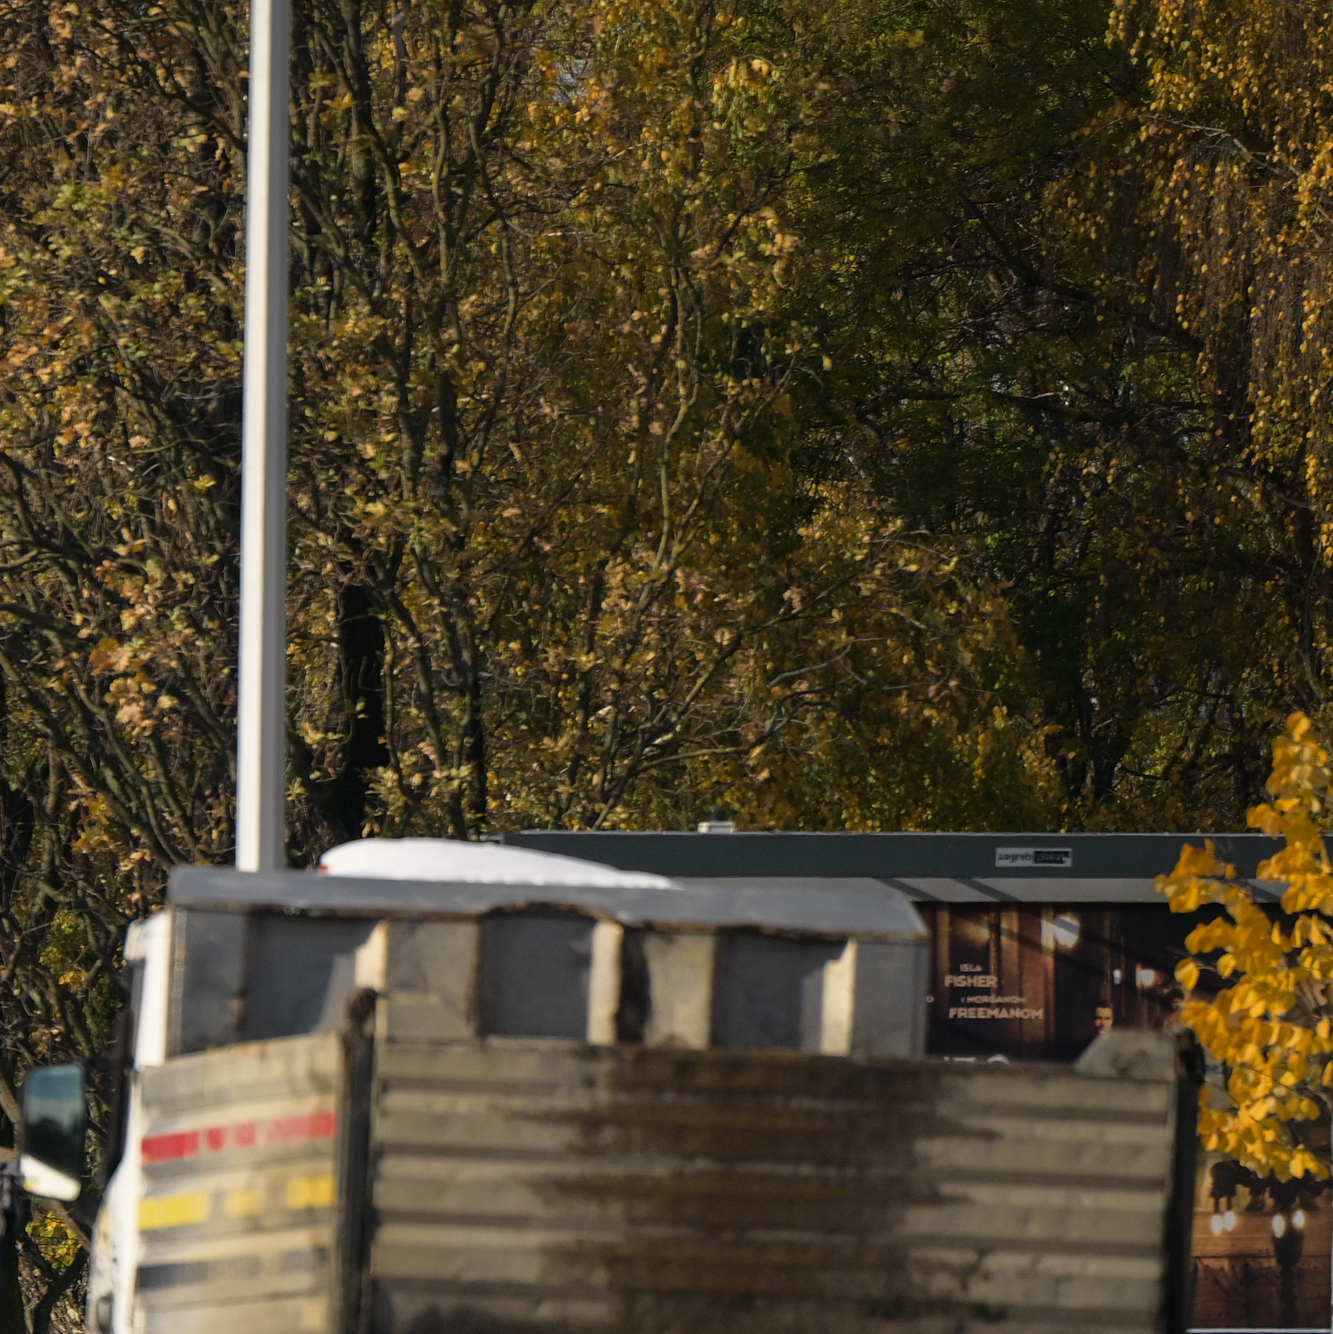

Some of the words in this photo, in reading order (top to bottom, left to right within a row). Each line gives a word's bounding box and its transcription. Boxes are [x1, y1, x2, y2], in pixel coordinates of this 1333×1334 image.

[960, 963, 983, 972] ISLA
[944, 975, 999, 988] FISHER
[966, 996, 1027, 1004] MORGANOM
[949, 1007, 1044, 1020] FREEMANOM
